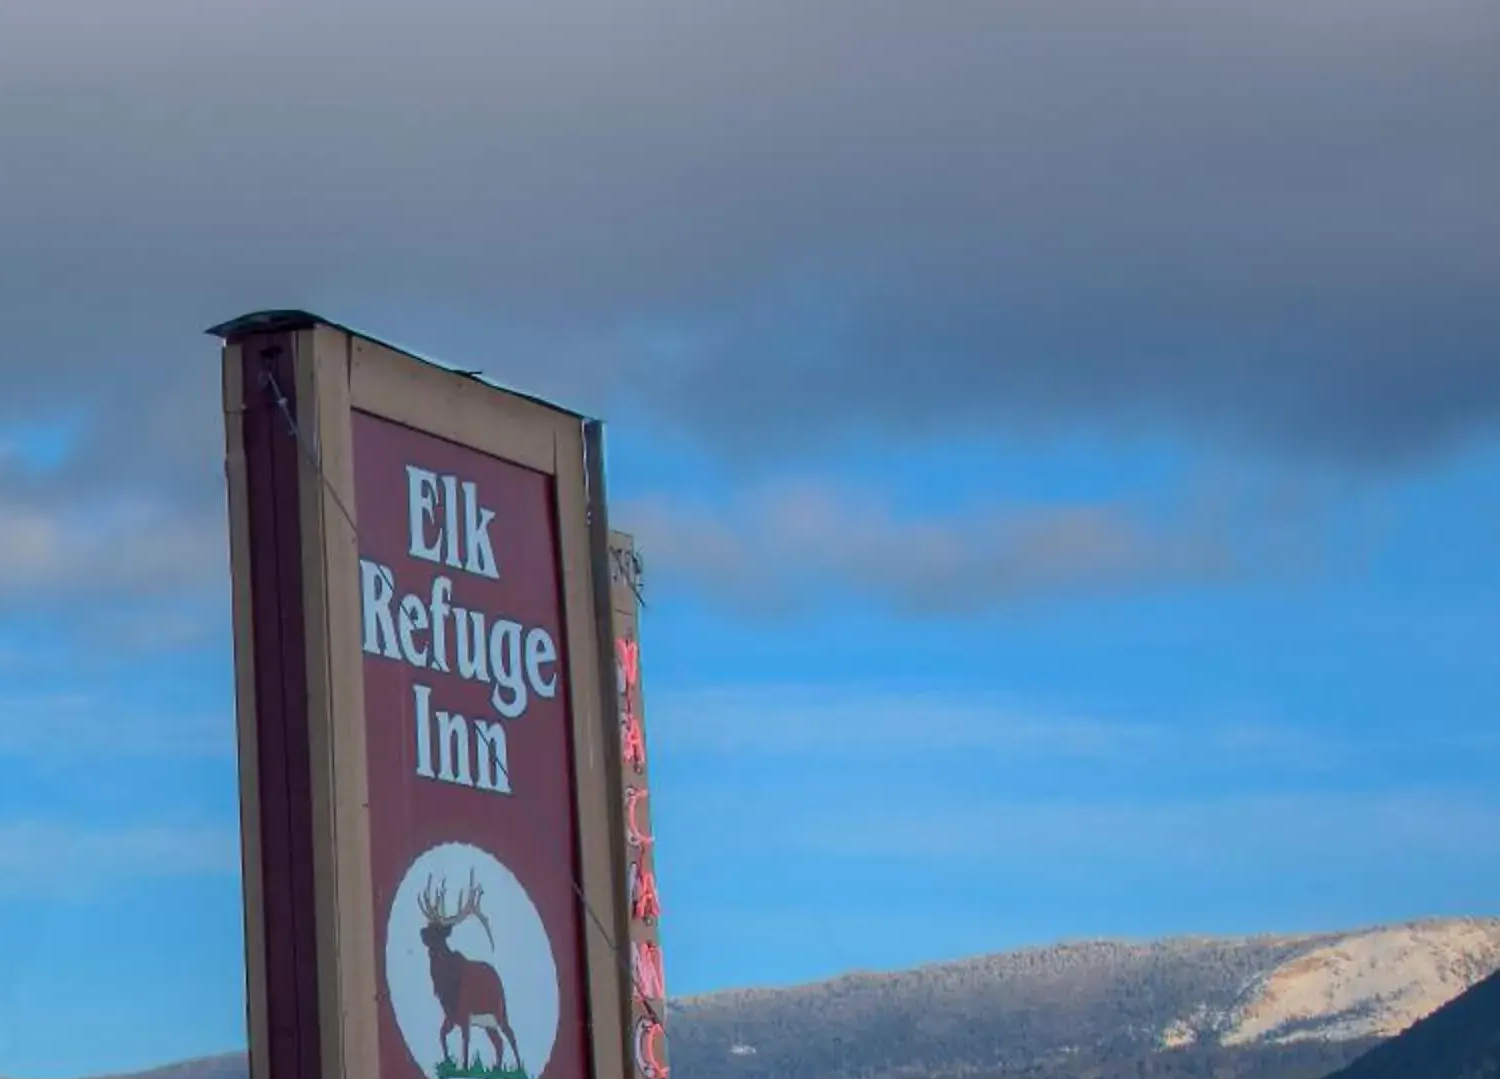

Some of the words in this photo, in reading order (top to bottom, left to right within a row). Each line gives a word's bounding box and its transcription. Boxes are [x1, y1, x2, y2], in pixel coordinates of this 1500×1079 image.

[405, 464, 500, 579] Elk
[359, 559, 557, 718] Refuge
[412, 684, 512, 794] Inn
